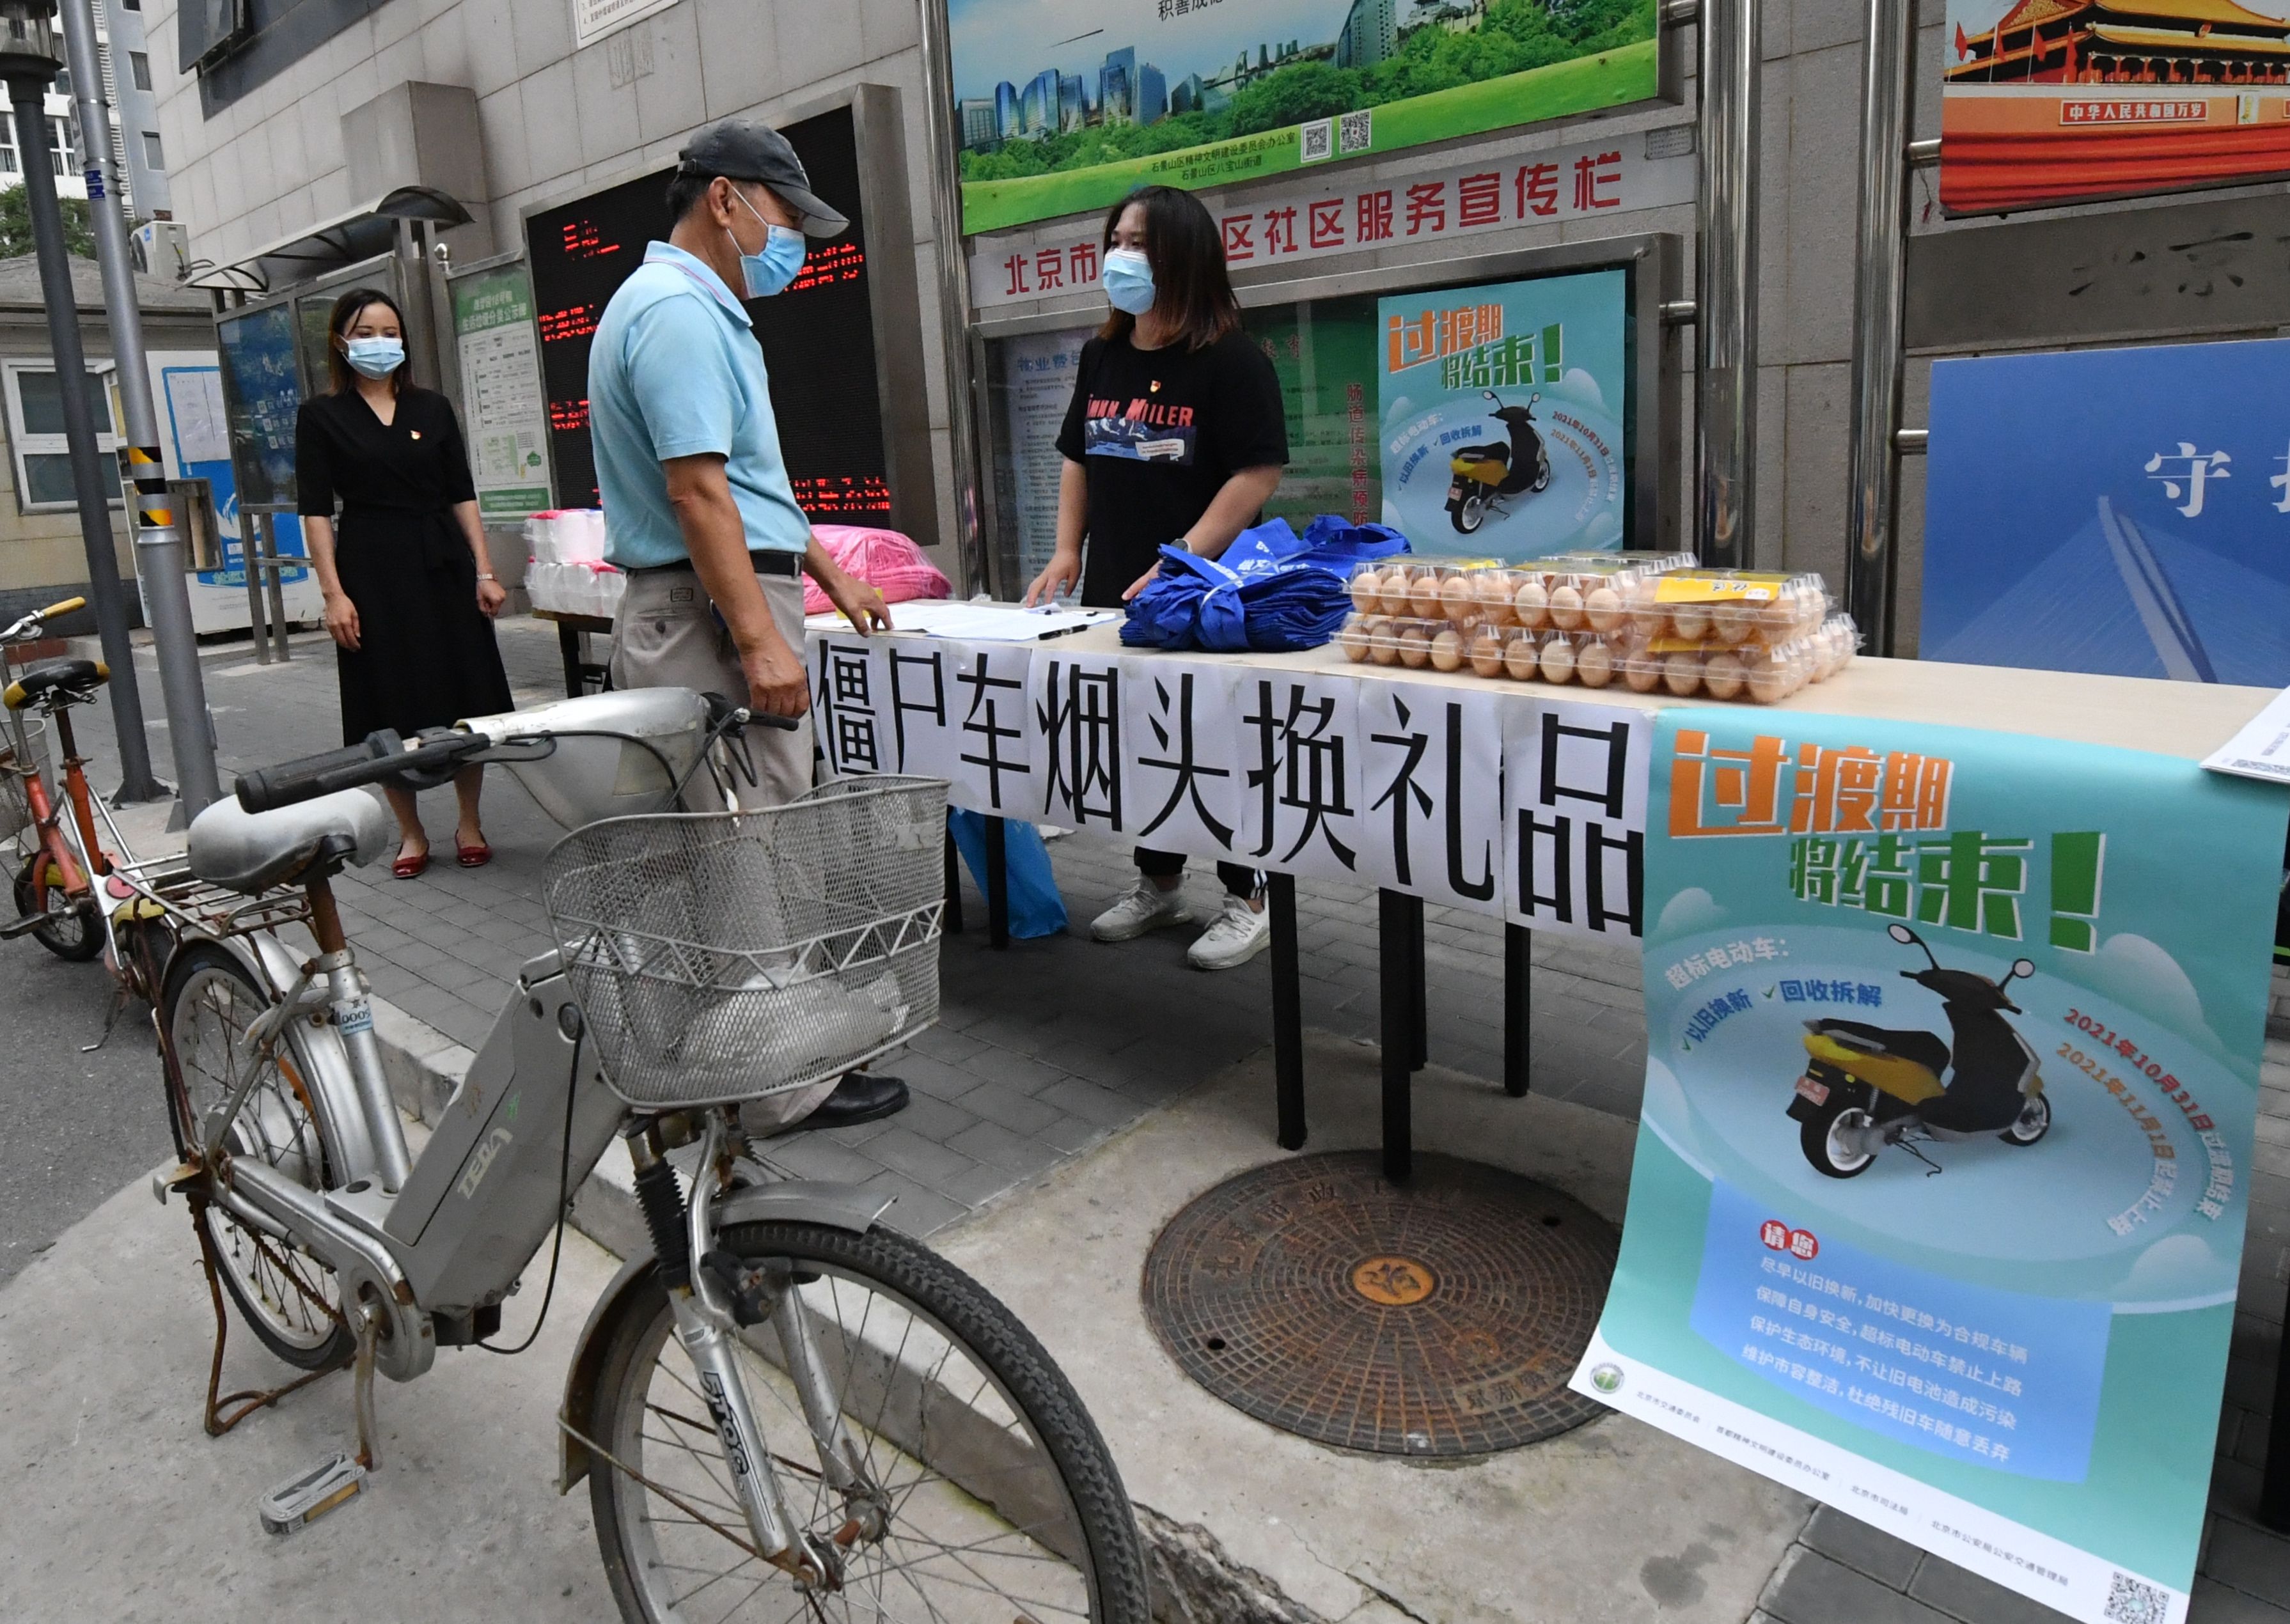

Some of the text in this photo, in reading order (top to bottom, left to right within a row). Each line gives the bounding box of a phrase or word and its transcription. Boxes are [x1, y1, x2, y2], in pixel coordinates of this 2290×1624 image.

[1158, 0, 1224, 22] 积善成
[1151, 132, 1296, 173] 石景山区精神文明建设委员会办公室
[2069, 103, 2201, 121] 中华人民共和国万岁
[1181, 154, 1262, 180] 石景山区八宝山街道
[1005, 151, 1622, 295] 北京市区社区服务宣传栏
[1388, 304, 1503, 373] 过渡期
[1439, 425, 1482, 445] 回收拆解
[815, 638, 1644, 935] 僵尸车烟头换礼品
[1669, 730, 1954, 839] 过渡期
[1688, 980, 1883, 1042] 以旧换新 回收拆解
[1763, 1222, 1815, 1258] 请您
[1755, 1285, 2023, 1396] 保障自身安全，超标电动车禁止上路
[1760, 1257, 2028, 1364] 尽早以旧换新，加快更换为合规车辆
[1742, 1344, 2011, 1463] 维护市容整洁，杜绝残旧车随意丢弃
[1750, 1315, 2018, 1430] 保护生态环境，不让旧电池造成污染
[1851, 1485, 1908, 1516] 北京市司法局
[1931, 1520, 2069, 1587] 北京市公安局公安交通管理局
